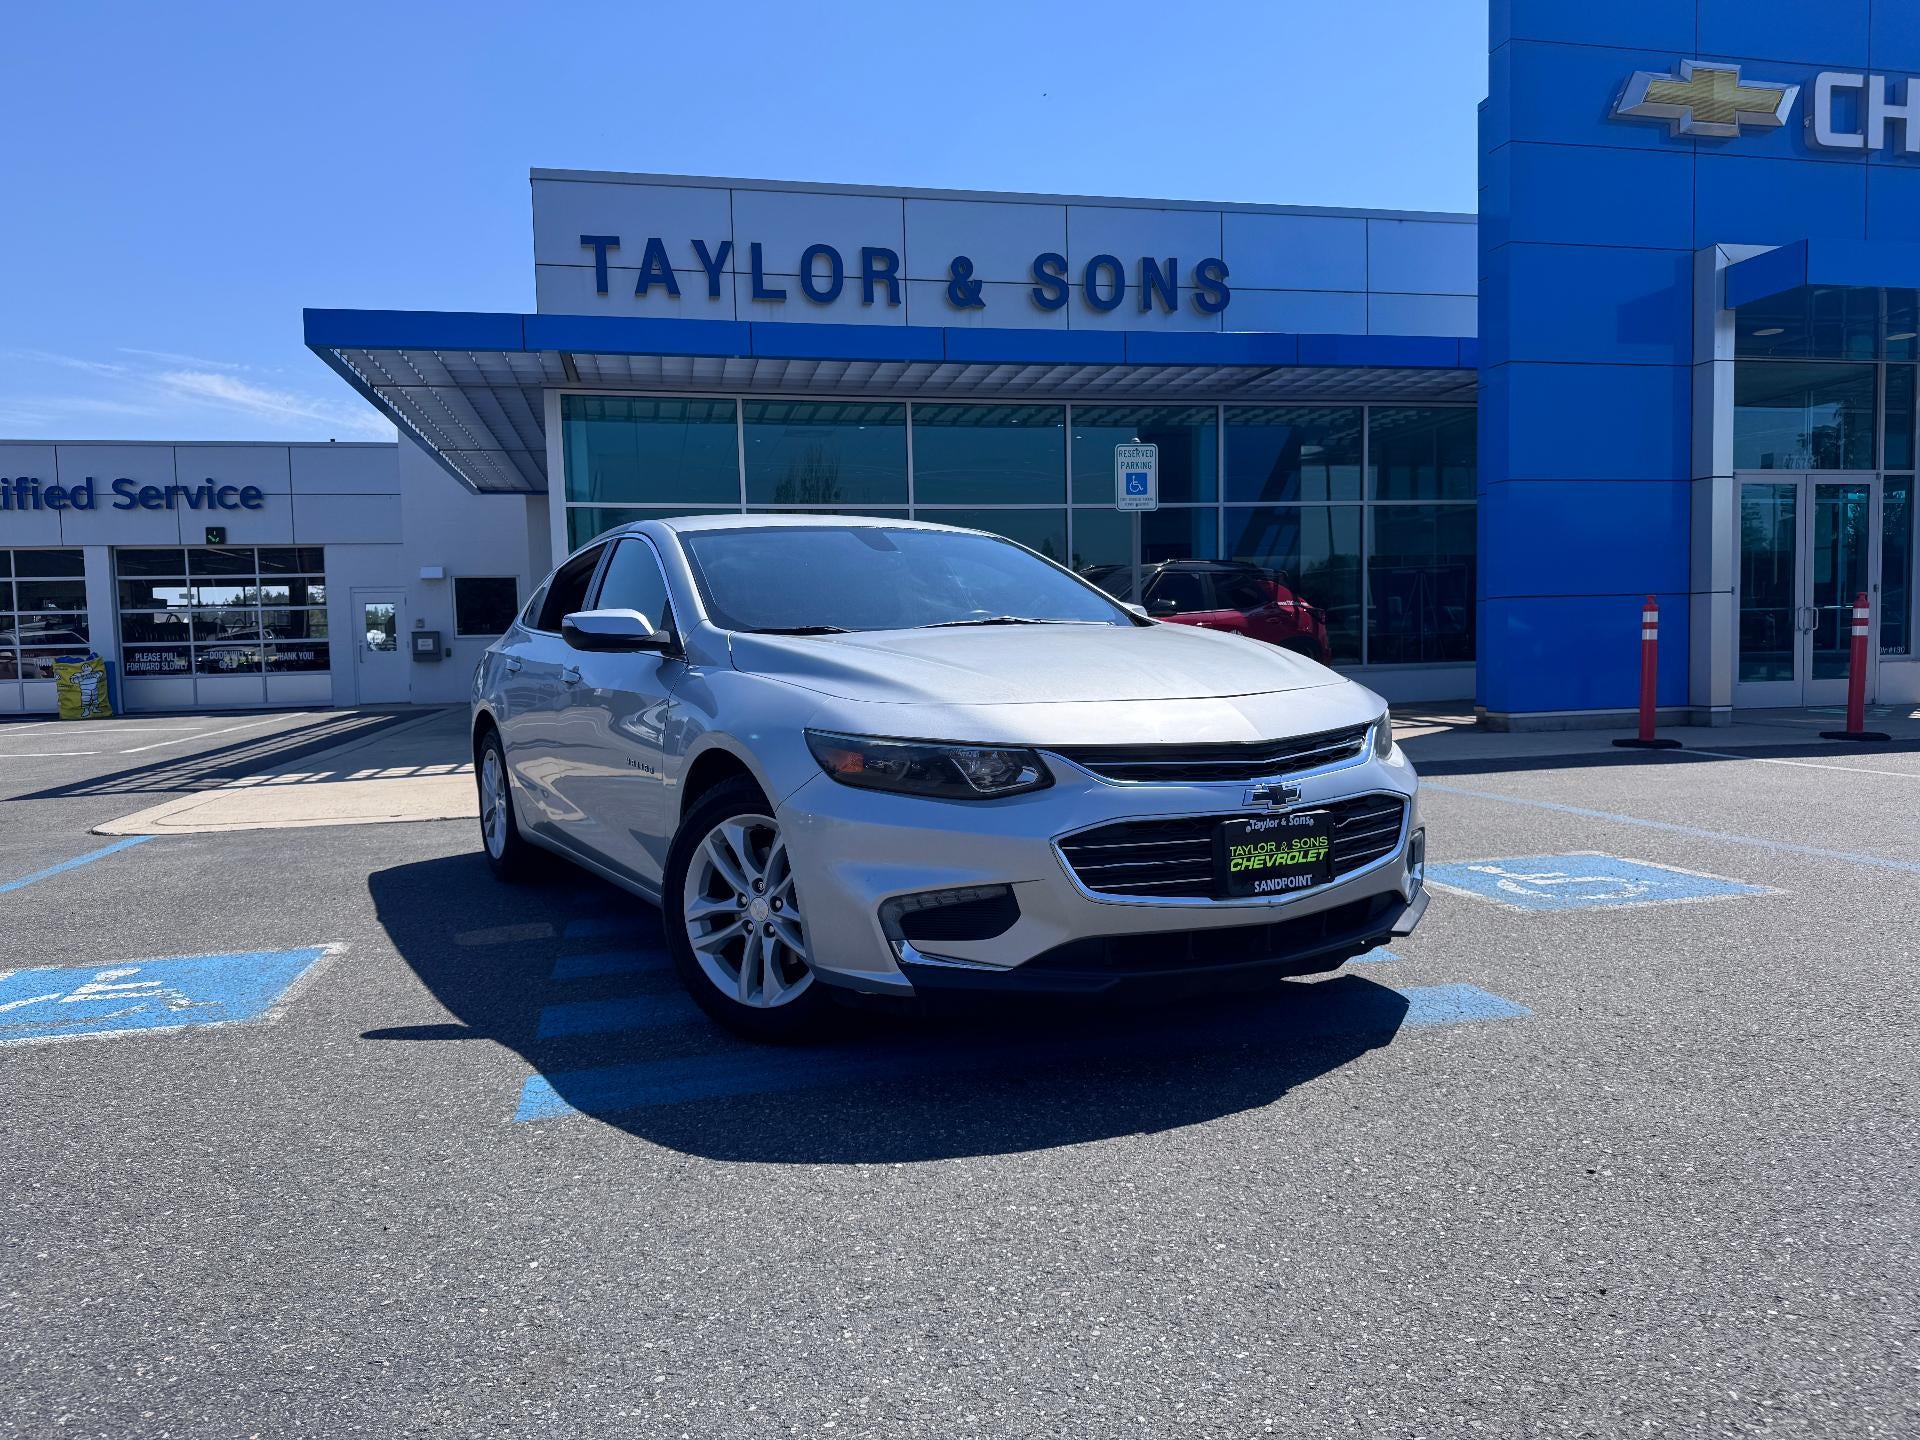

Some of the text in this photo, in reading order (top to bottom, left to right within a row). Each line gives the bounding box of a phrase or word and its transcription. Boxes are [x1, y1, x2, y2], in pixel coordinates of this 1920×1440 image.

[1815, 71, 1920, 152] CH
[580, 235, 1231, 313] TAYLOR & SONS
[1119, 449, 1154, 458] RESERVED
[1120, 461, 1152, 470] PARKING
[111, 478, 263, 510] Service
[136, 652, 160, 661] PLEASE
[276, 652, 314, 660] THANK YOU!
[126, 662, 160, 671] FORWARD
[1250, 814, 1312, 831] Taylor & Sons
[1230, 836, 1328, 856] TAYLOR & SONS
[1231, 848, 1328, 872] CHEVROLET
[1254, 874, 1312, 892] SANDPOINT
